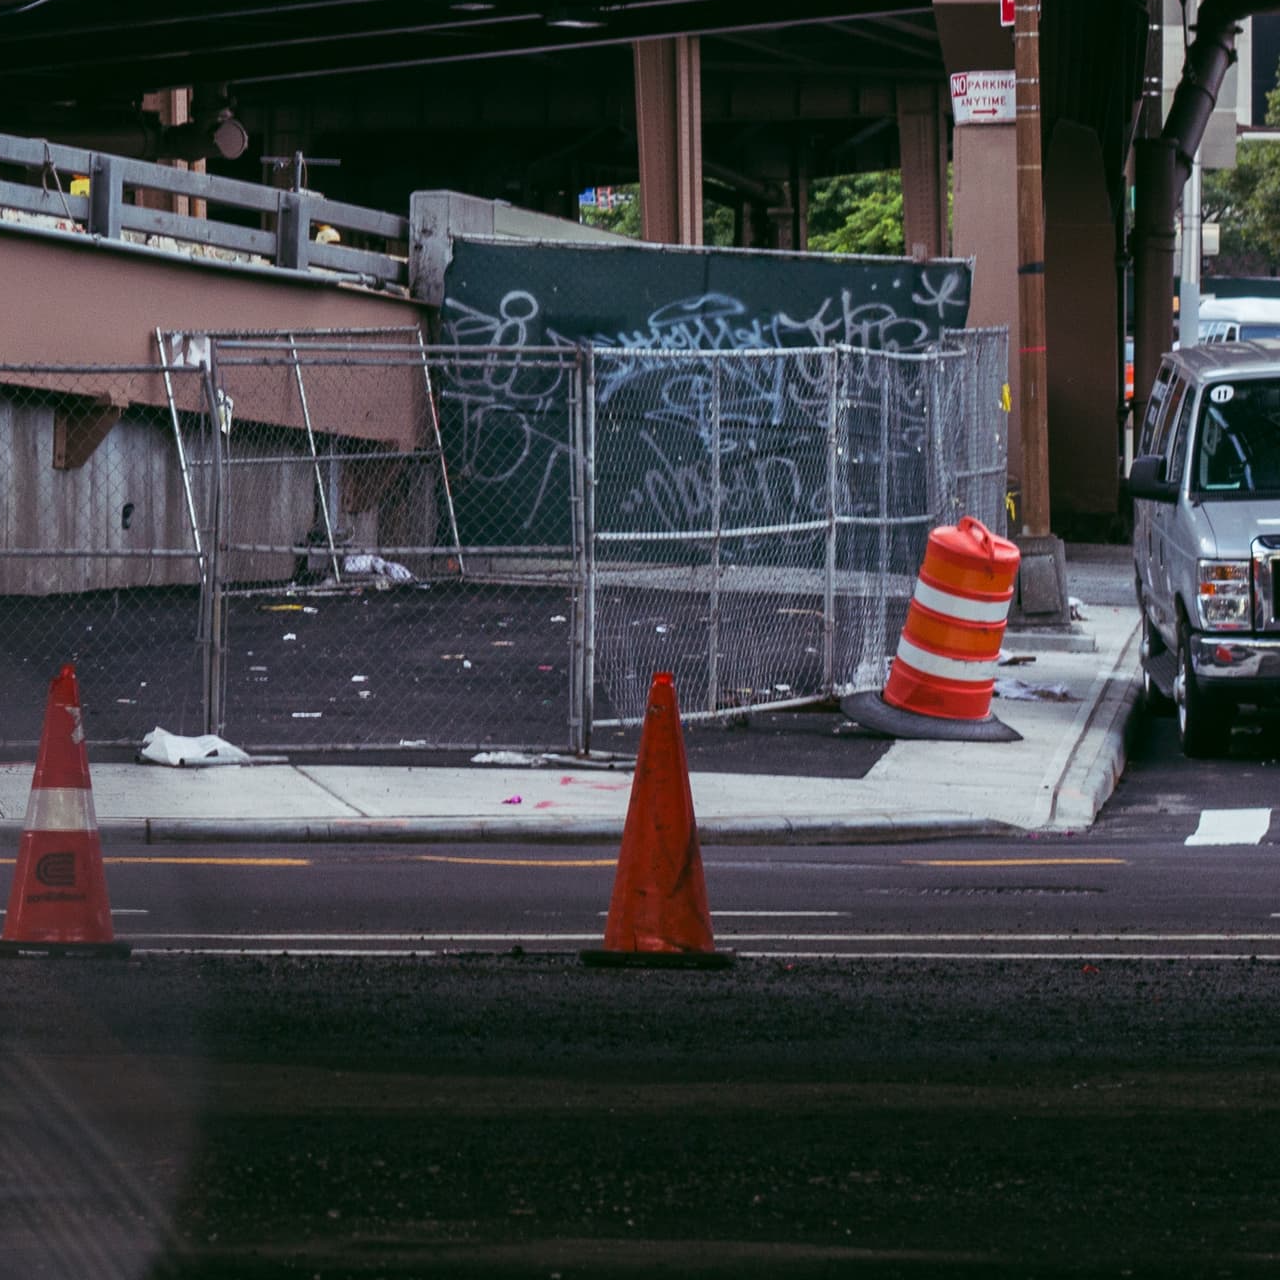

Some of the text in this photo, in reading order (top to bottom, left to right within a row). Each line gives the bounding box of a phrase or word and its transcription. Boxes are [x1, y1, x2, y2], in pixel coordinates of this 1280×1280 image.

[952, 76, 1015, 95] NO PARKING
[961, 96, 1007, 107] ANYTIME
